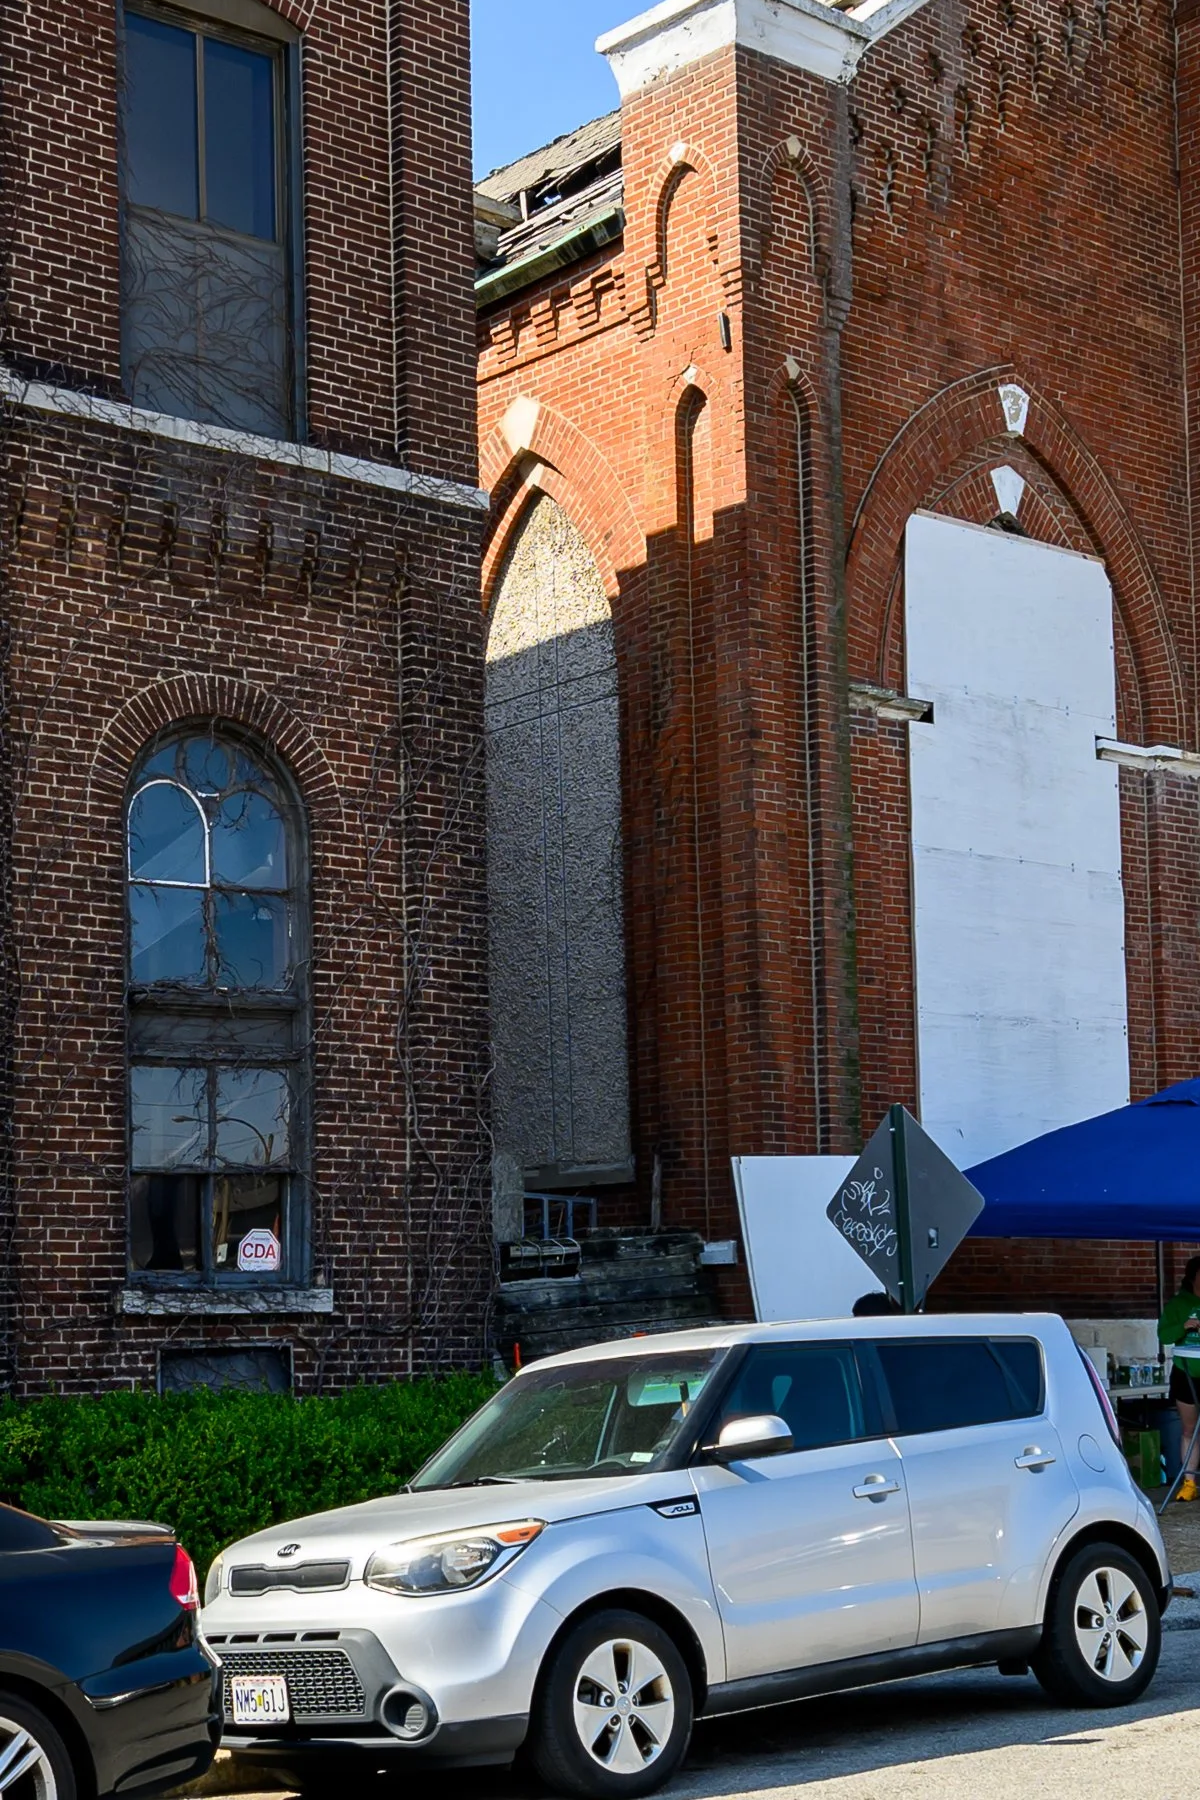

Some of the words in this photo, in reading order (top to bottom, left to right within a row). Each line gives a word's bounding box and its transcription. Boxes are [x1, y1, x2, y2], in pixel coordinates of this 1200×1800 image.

[242, 1243, 276, 1259] CDA
[235, 1688, 257, 1713] NM5
[262, 1688, 285, 1713] G1J
